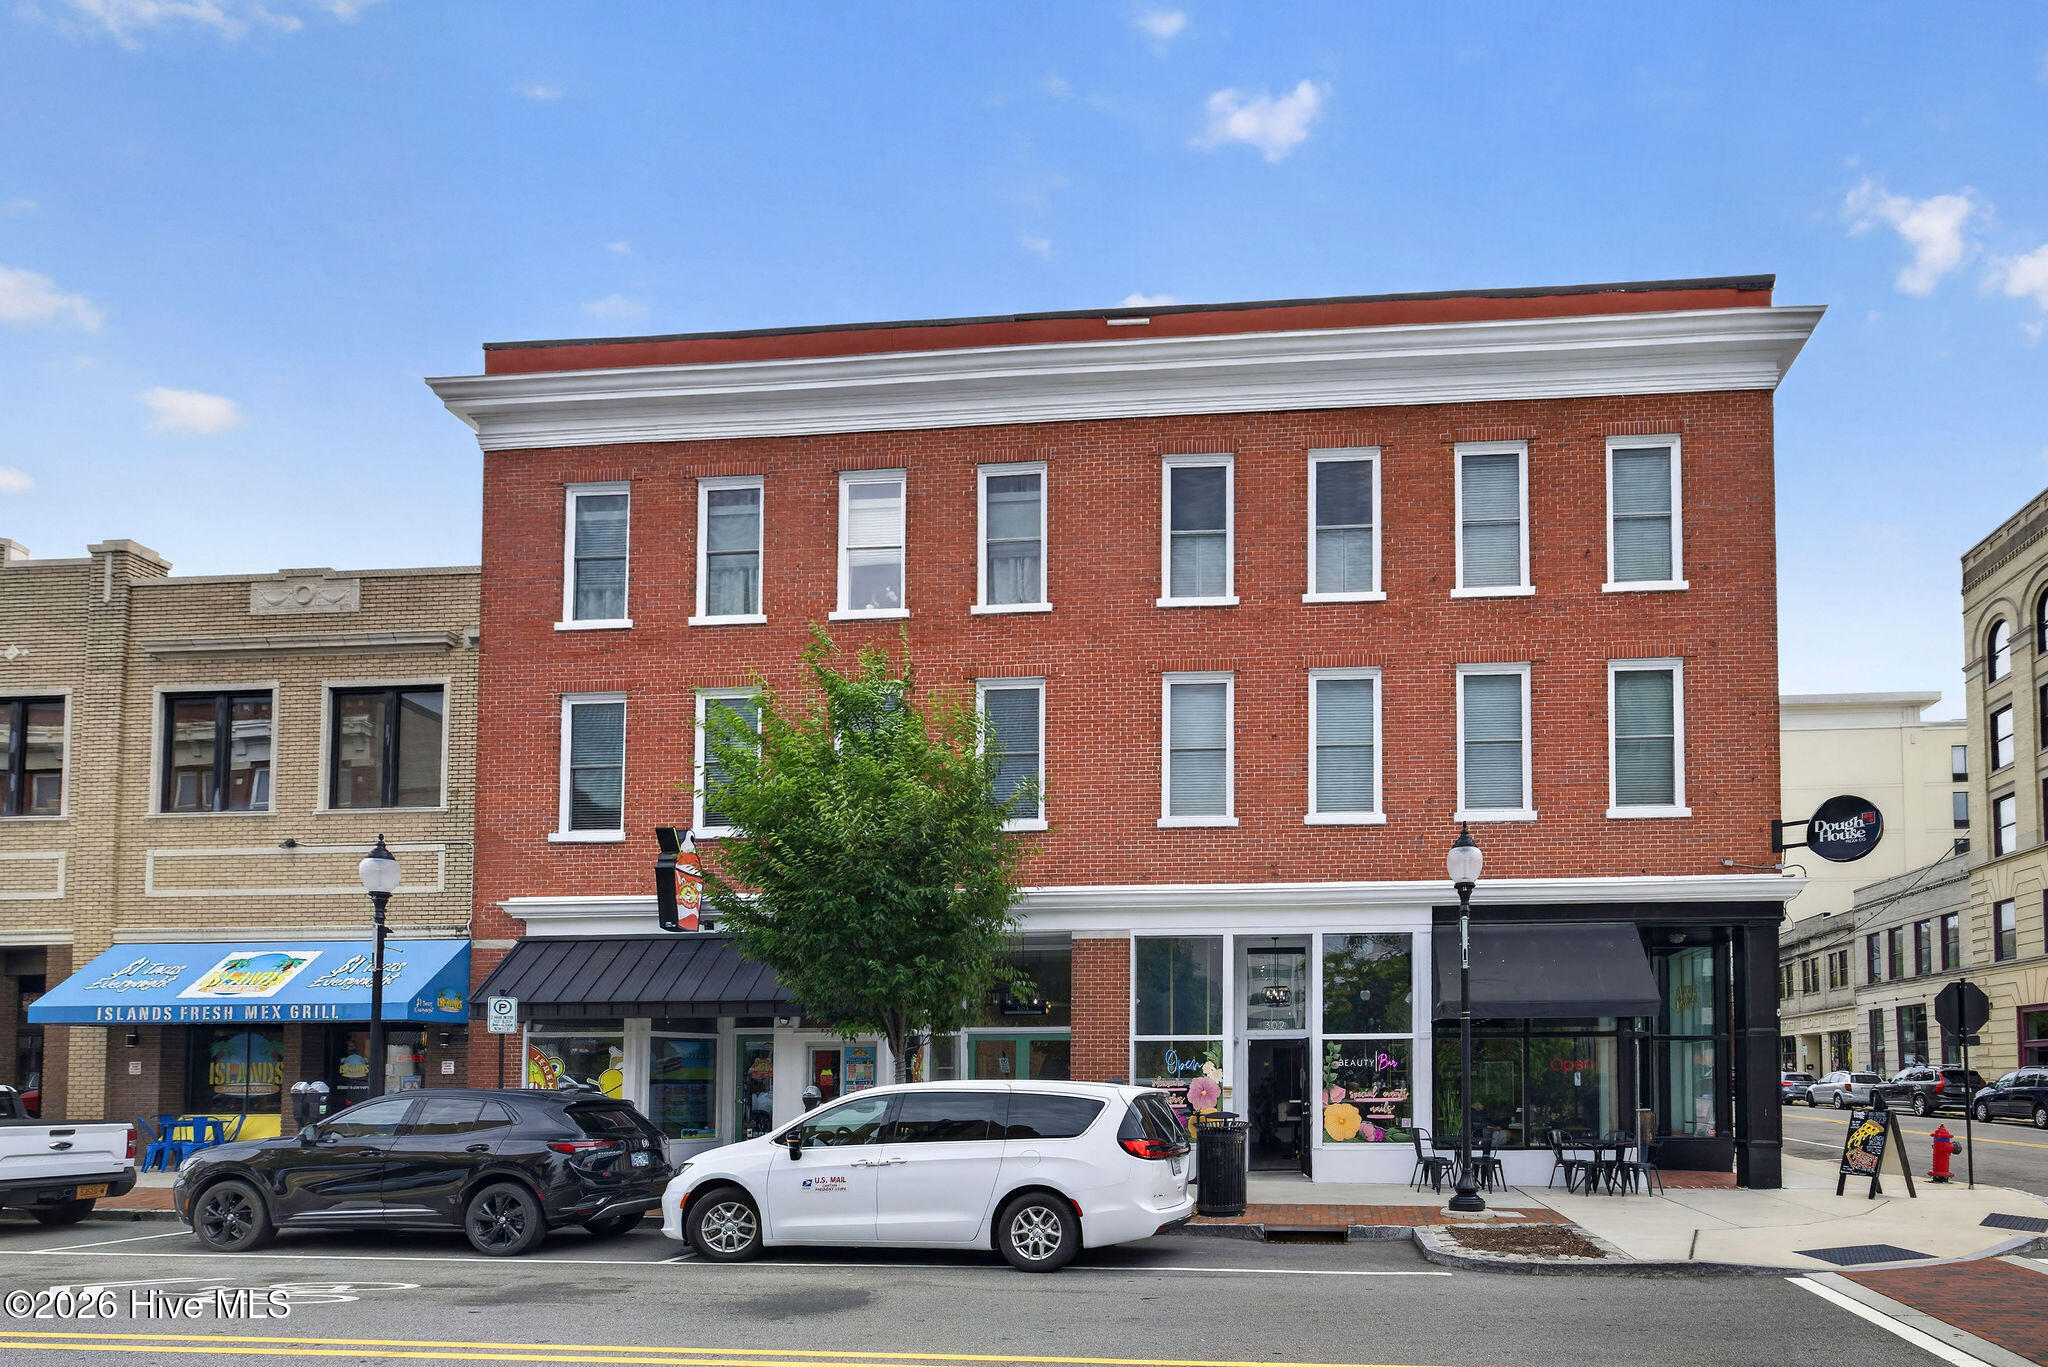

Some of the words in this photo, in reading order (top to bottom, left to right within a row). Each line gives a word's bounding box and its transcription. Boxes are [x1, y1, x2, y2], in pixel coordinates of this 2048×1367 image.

[1814, 816, 1866, 832] Dough
[1820, 828, 1867, 842] House
[362, 960, 408, 974] Tcos
[96, 1007, 172, 1020] ISLANDS
[180, 1006, 233, 1020] FRESH
[244, 1005, 281, 1019] MEX
[289, 1004, 339, 1019] GRILL
[1264, 1020, 1285, 1031] 302
[1165, 1049, 1204, 1079] Open
[1339, 1059, 1375, 1067] BEAUTY
[1378, 1053, 1398, 1071] Bar
[1550, 1057, 1594, 1075] Open
[1369, 1101, 1396, 1115] nails
